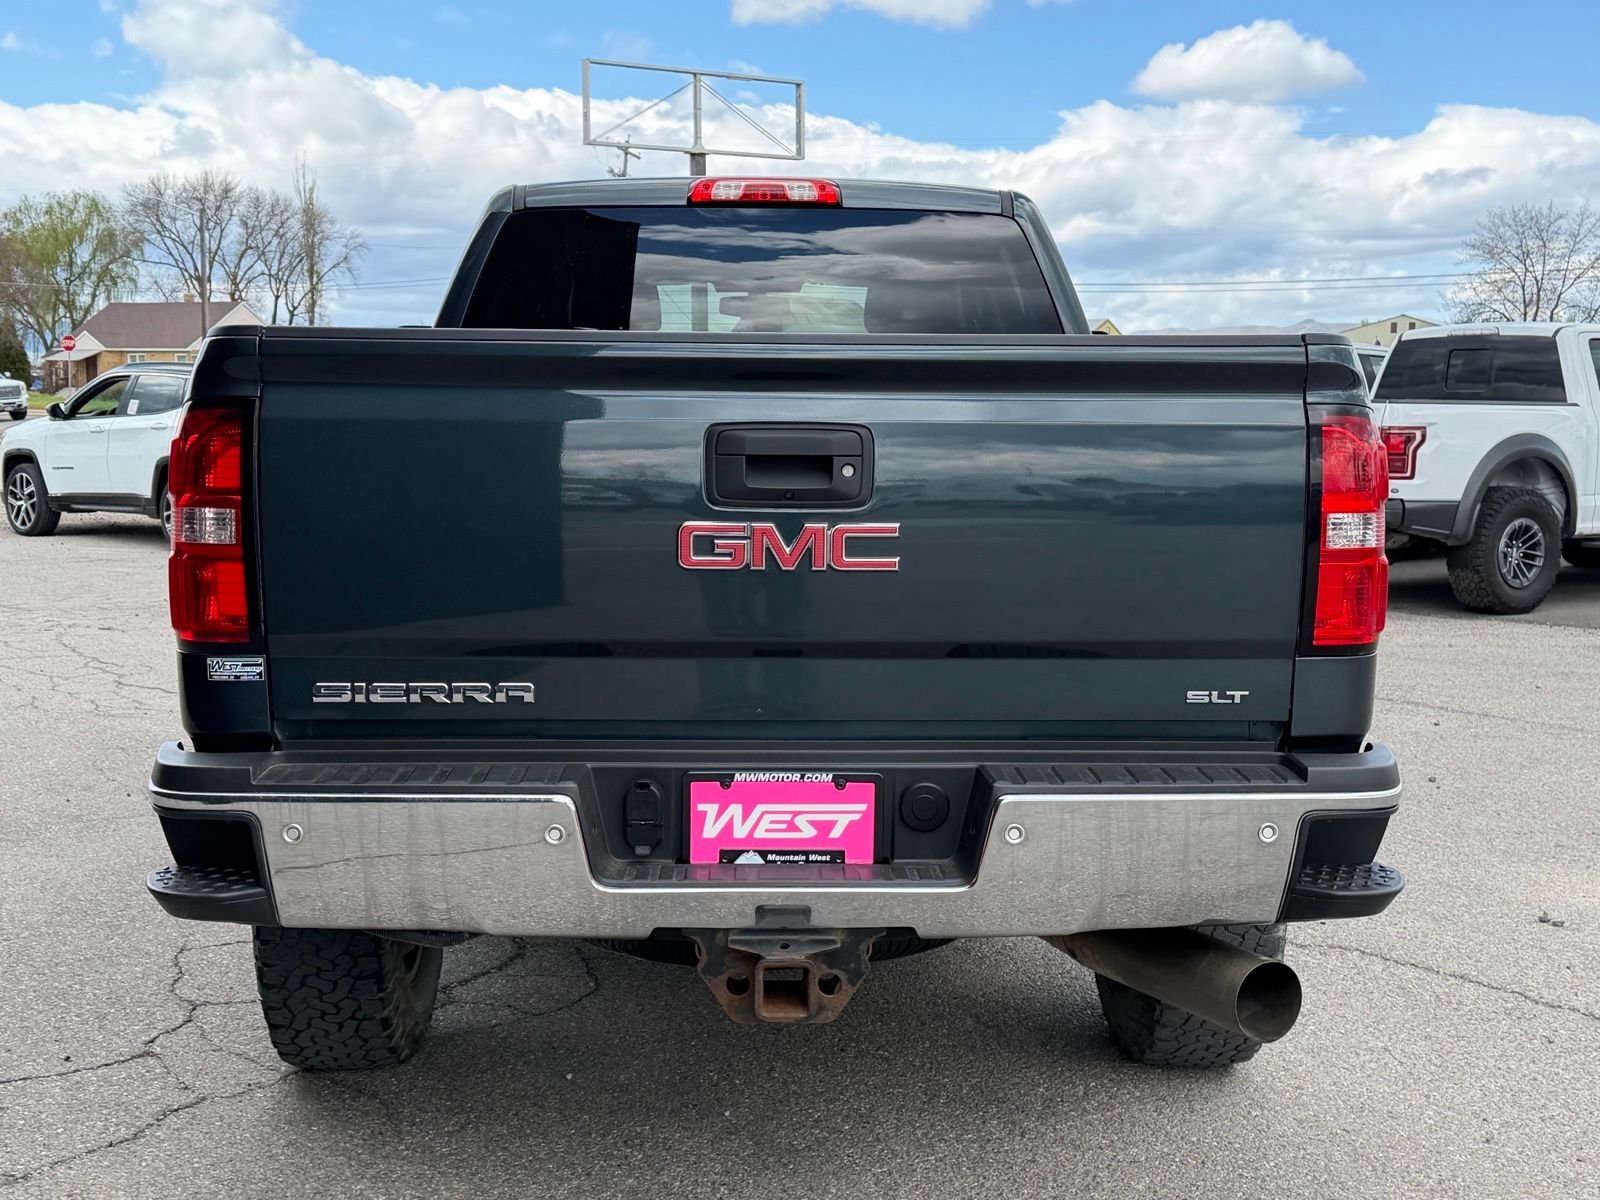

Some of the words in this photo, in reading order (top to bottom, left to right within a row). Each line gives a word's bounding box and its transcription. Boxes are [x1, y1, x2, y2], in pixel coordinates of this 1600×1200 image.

[678, 520, 900, 571] GMC
[312, 682, 535, 704] SIERRA
[1186, 690, 1250, 704] SLT
[734, 772, 833, 783] MWMOTOR.COM
[697, 804, 868, 839] WEST
[766, 853, 806, 861] Mountain
